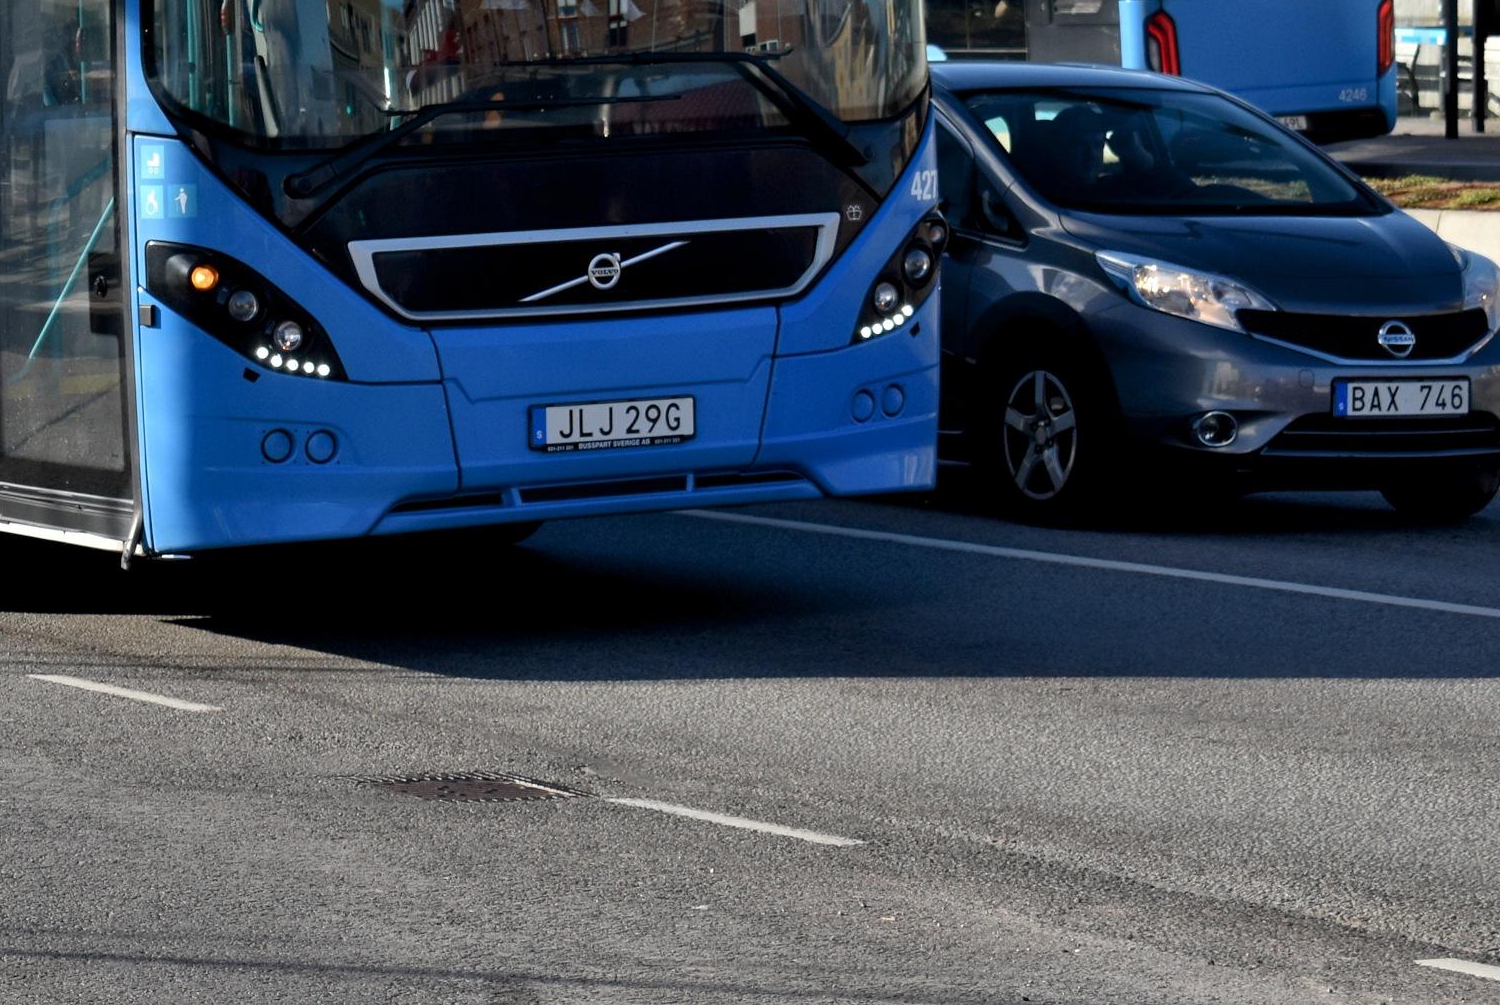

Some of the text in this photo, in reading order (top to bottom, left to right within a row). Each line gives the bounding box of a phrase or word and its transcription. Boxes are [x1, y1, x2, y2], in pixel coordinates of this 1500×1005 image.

[1339, 88, 1367, 102] 4246
[591, 268, 619, 276] VOLVO
[1352, 384, 1463, 412] BAX 746
[559, 403, 681, 438] JLJ 29G
